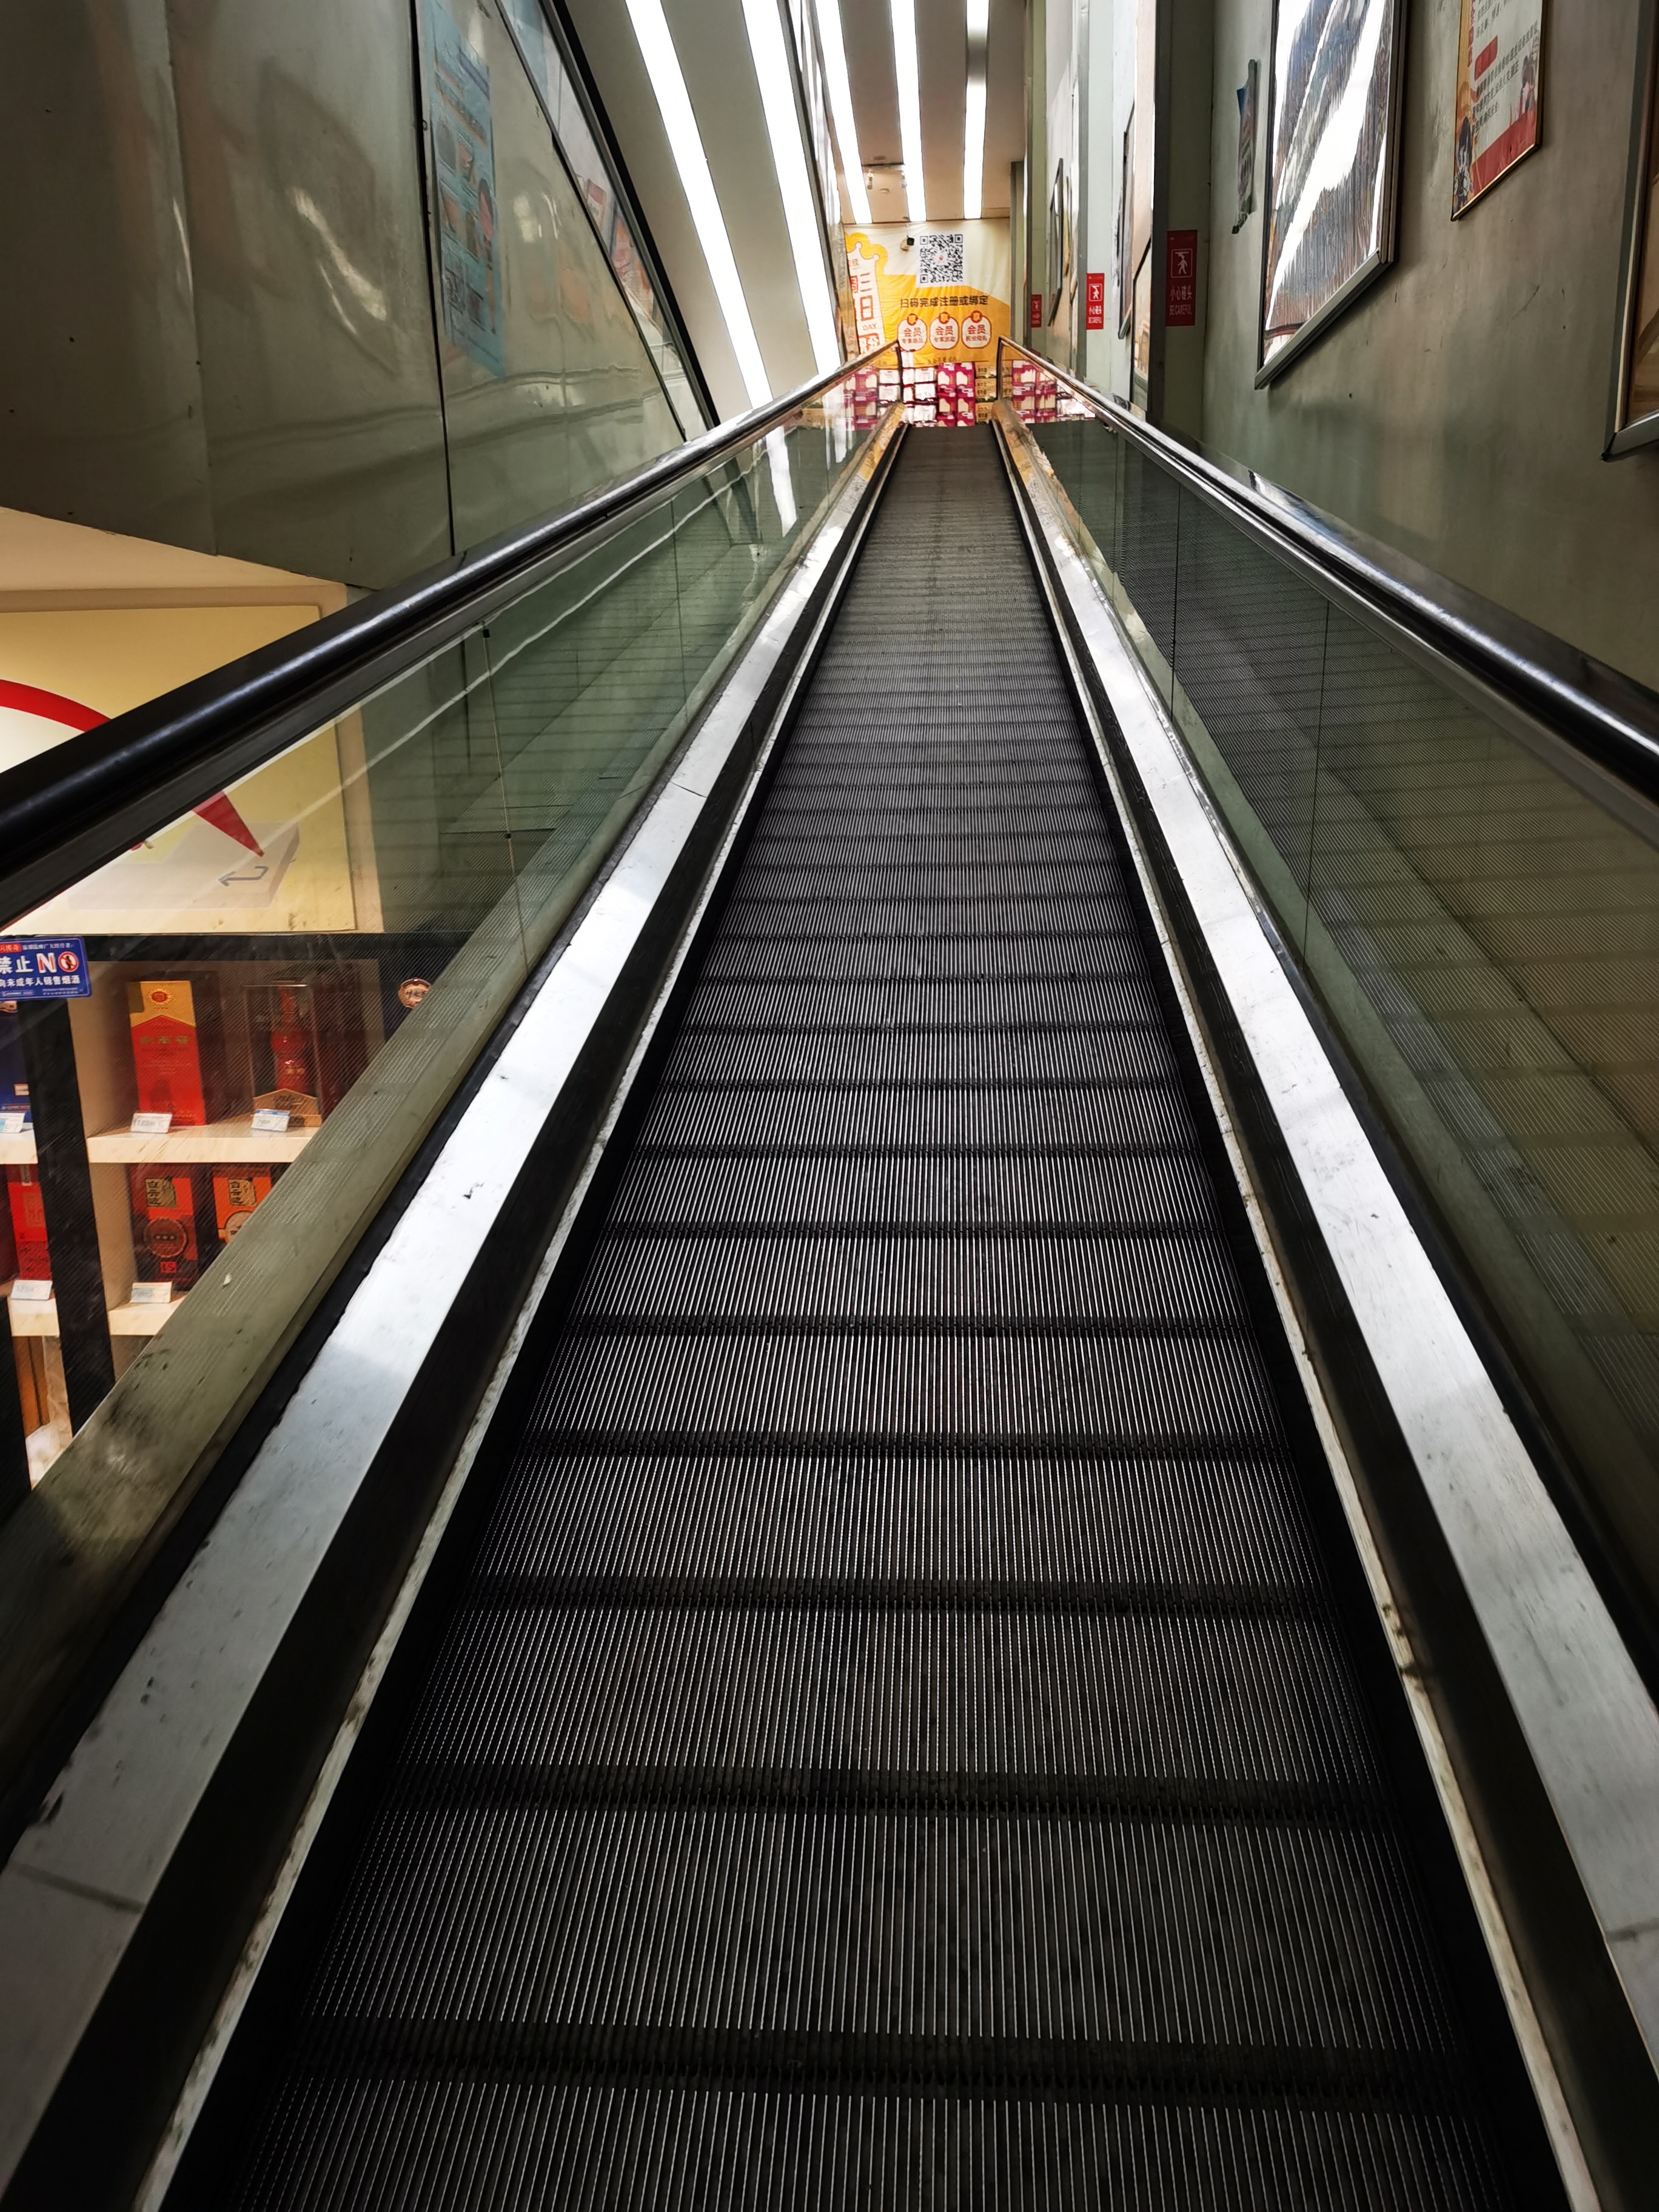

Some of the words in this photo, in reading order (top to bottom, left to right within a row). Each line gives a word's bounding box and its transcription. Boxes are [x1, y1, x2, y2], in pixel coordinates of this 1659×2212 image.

[862, 323, 877, 331] DAY
[935, 326, 953, 335] 会员
[967, 324, 986, 334] 会员
[903, 327, 922, 337] 会员
